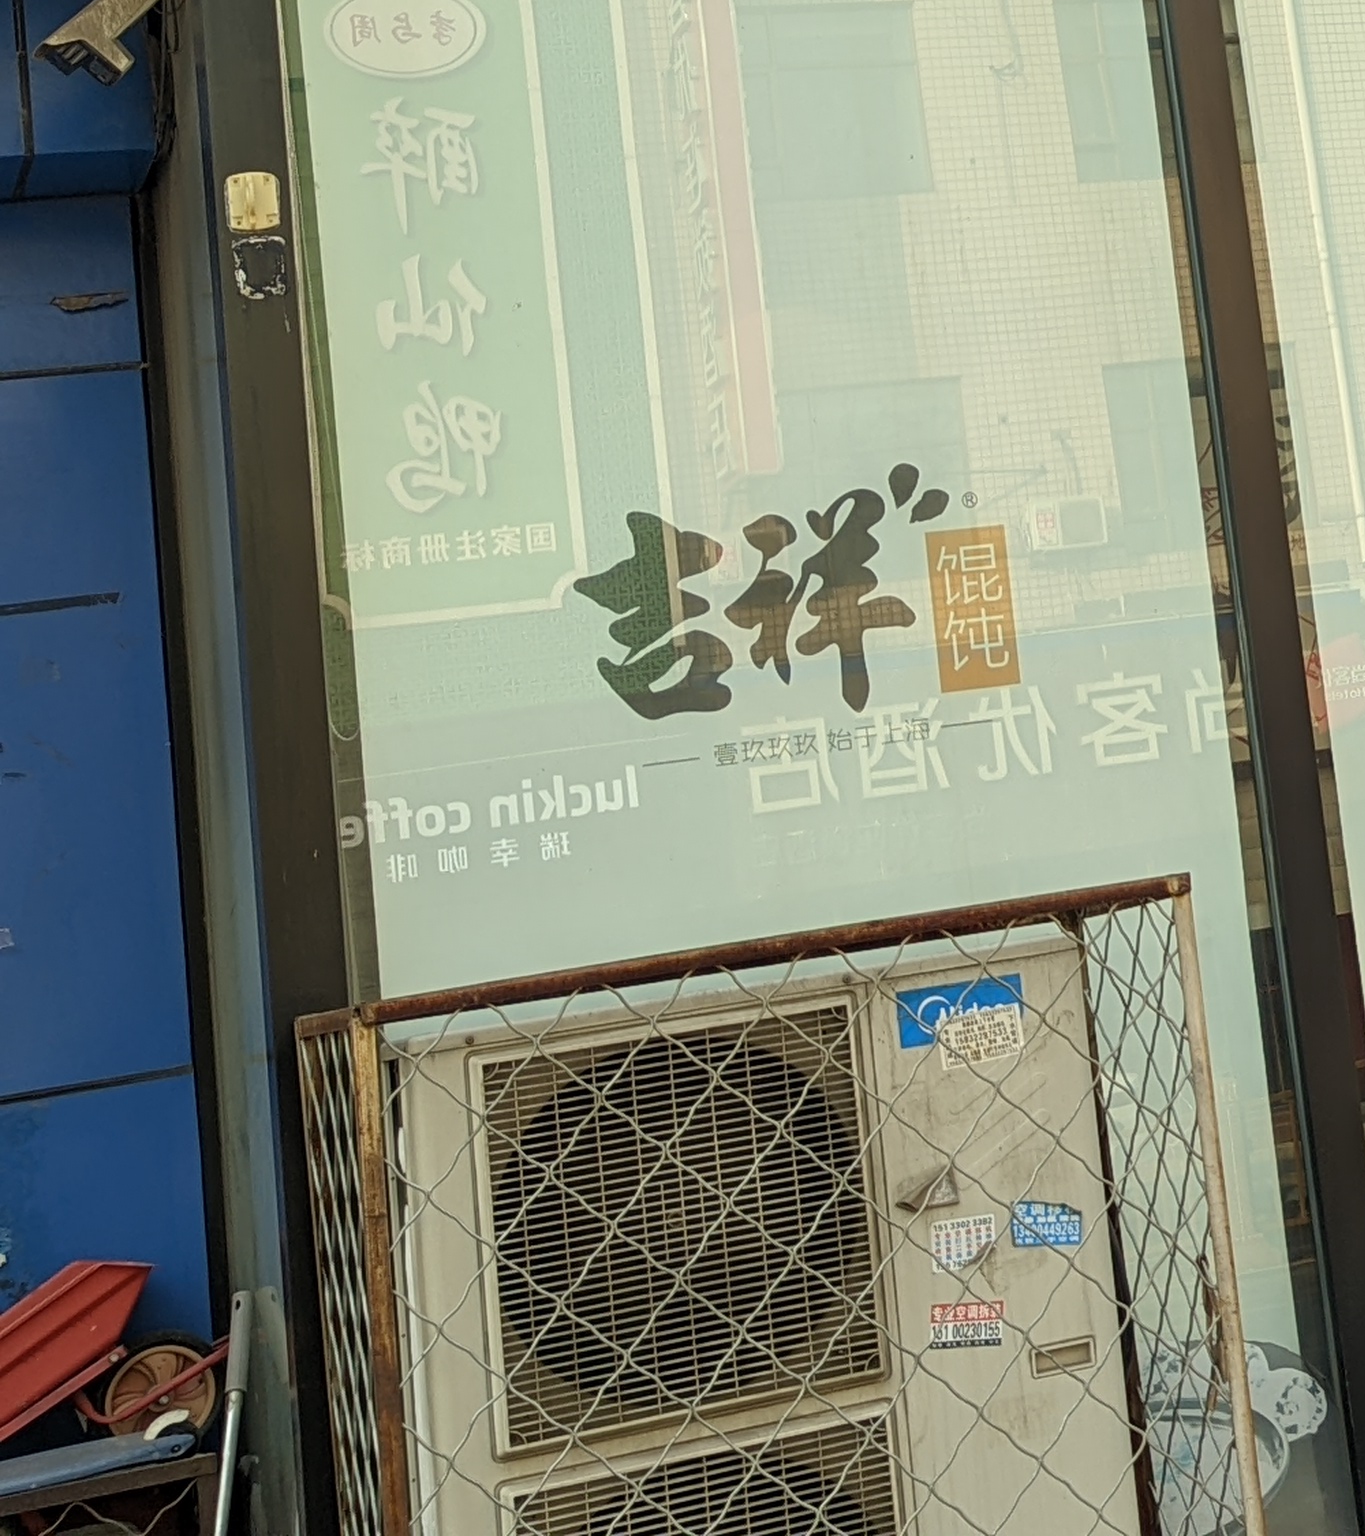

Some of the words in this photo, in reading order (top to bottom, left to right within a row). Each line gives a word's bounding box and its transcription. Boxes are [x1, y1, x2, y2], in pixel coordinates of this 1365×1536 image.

[571, 463, 950, 721] 吉祥
[935, 542, 1011, 674] 馄饨
[711, 732, 821, 769] 壹玖玖玖
[826, 715, 934, 756] 始于上海
